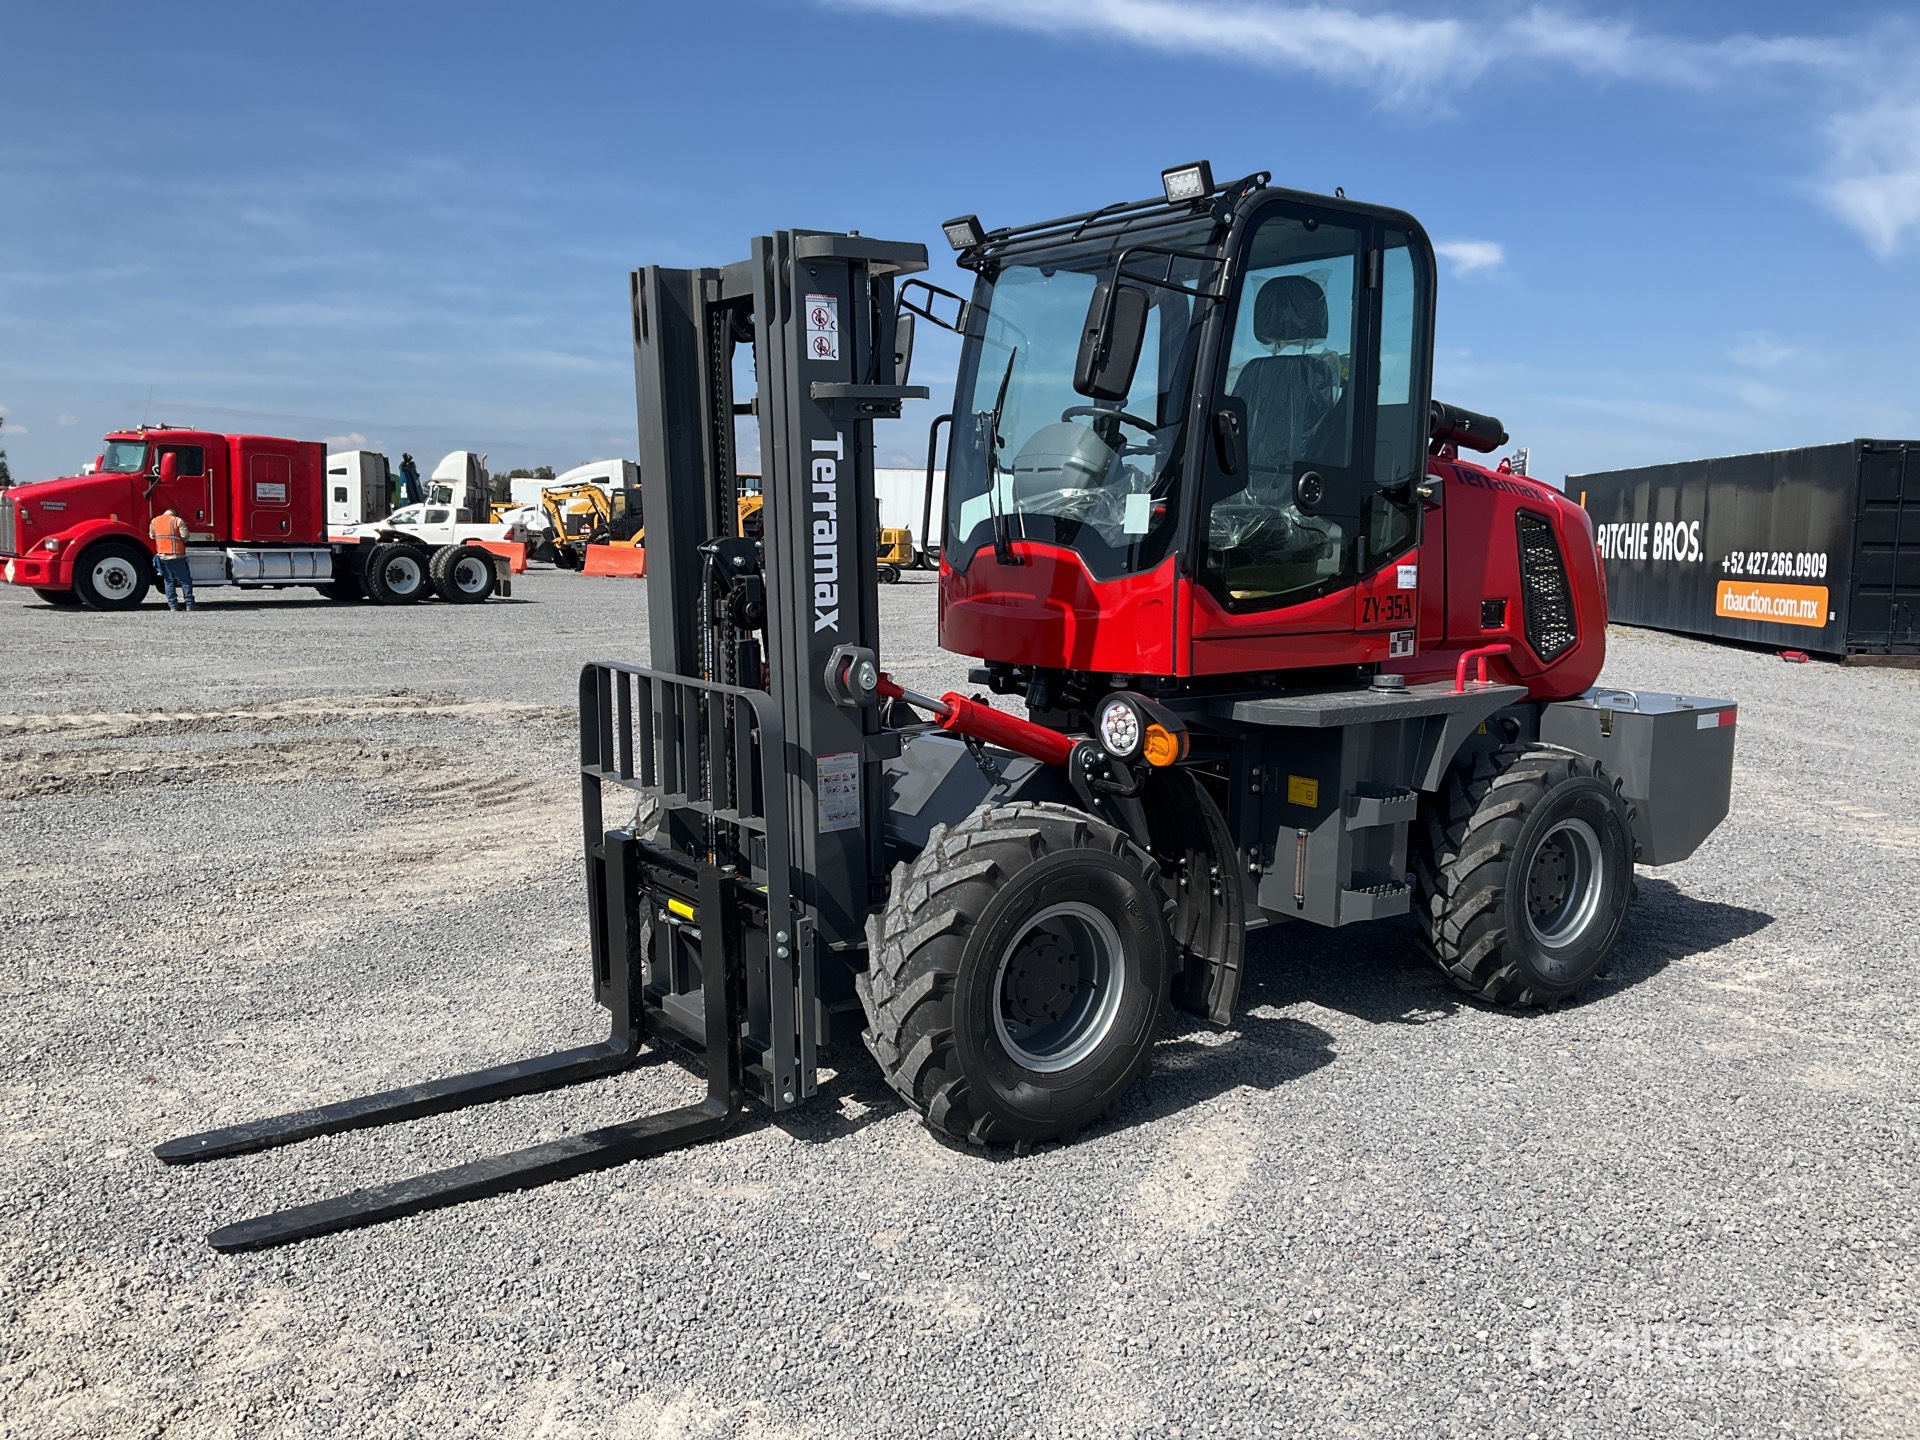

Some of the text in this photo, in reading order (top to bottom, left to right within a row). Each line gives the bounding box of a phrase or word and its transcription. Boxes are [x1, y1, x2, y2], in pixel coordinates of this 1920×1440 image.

[1450, 464, 1546, 503] Terramax
[811, 431, 844, 634] Terramax
[1597, 520, 1704, 562] RITCHIE BROS.
[1722, 551, 1828, 578] +52 427.266.0909
[1362, 594, 1412, 624] ZY-35A
[1723, 587, 1819, 619] rbauction.com.mx
